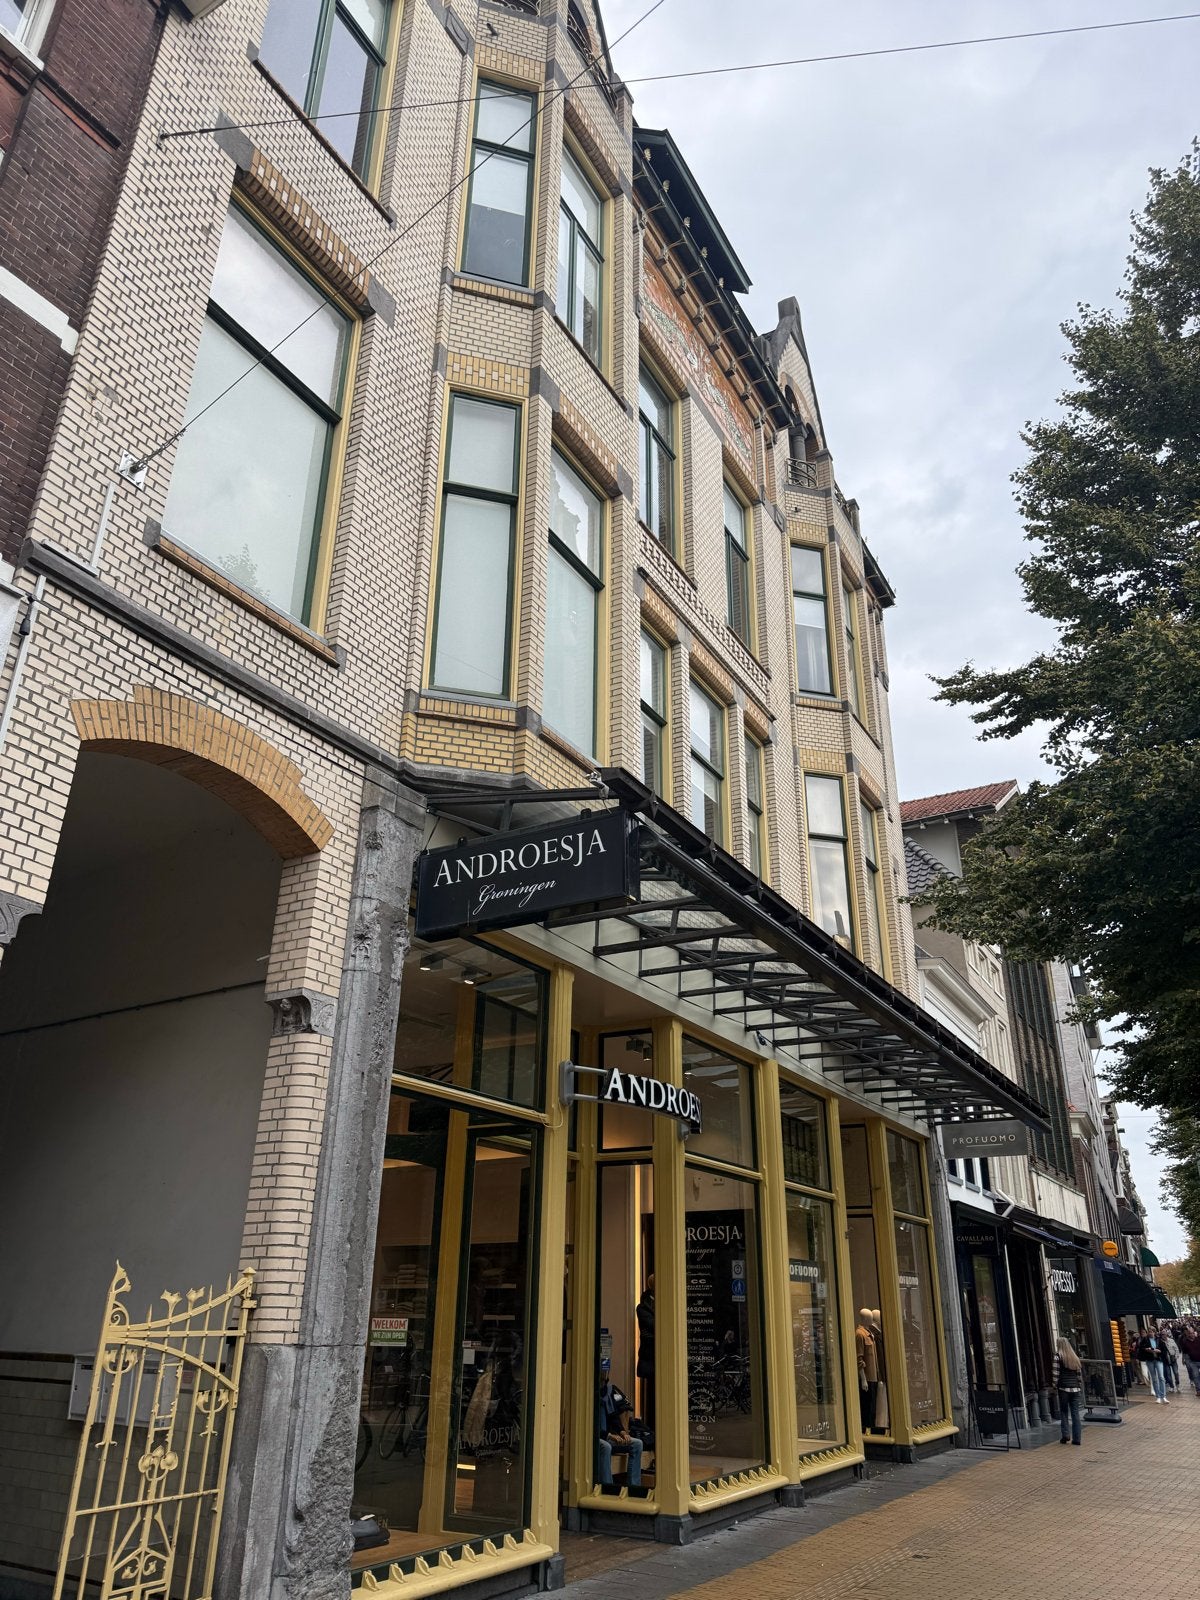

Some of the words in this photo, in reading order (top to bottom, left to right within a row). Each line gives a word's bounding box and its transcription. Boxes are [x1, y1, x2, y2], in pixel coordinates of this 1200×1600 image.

[433, 829, 607, 888] ANDROESJA
[472, 878, 556, 916] Groningen
[953, 1134, 1016, 1145] PROFUOMO
[687, 1225, 741, 1245] ROESJA
[789, 1264, 819, 1278] OFUOMO
[898, 1275, 918, 1286] OFUOMO
[392, 1331, 405, 1340] OPEN
